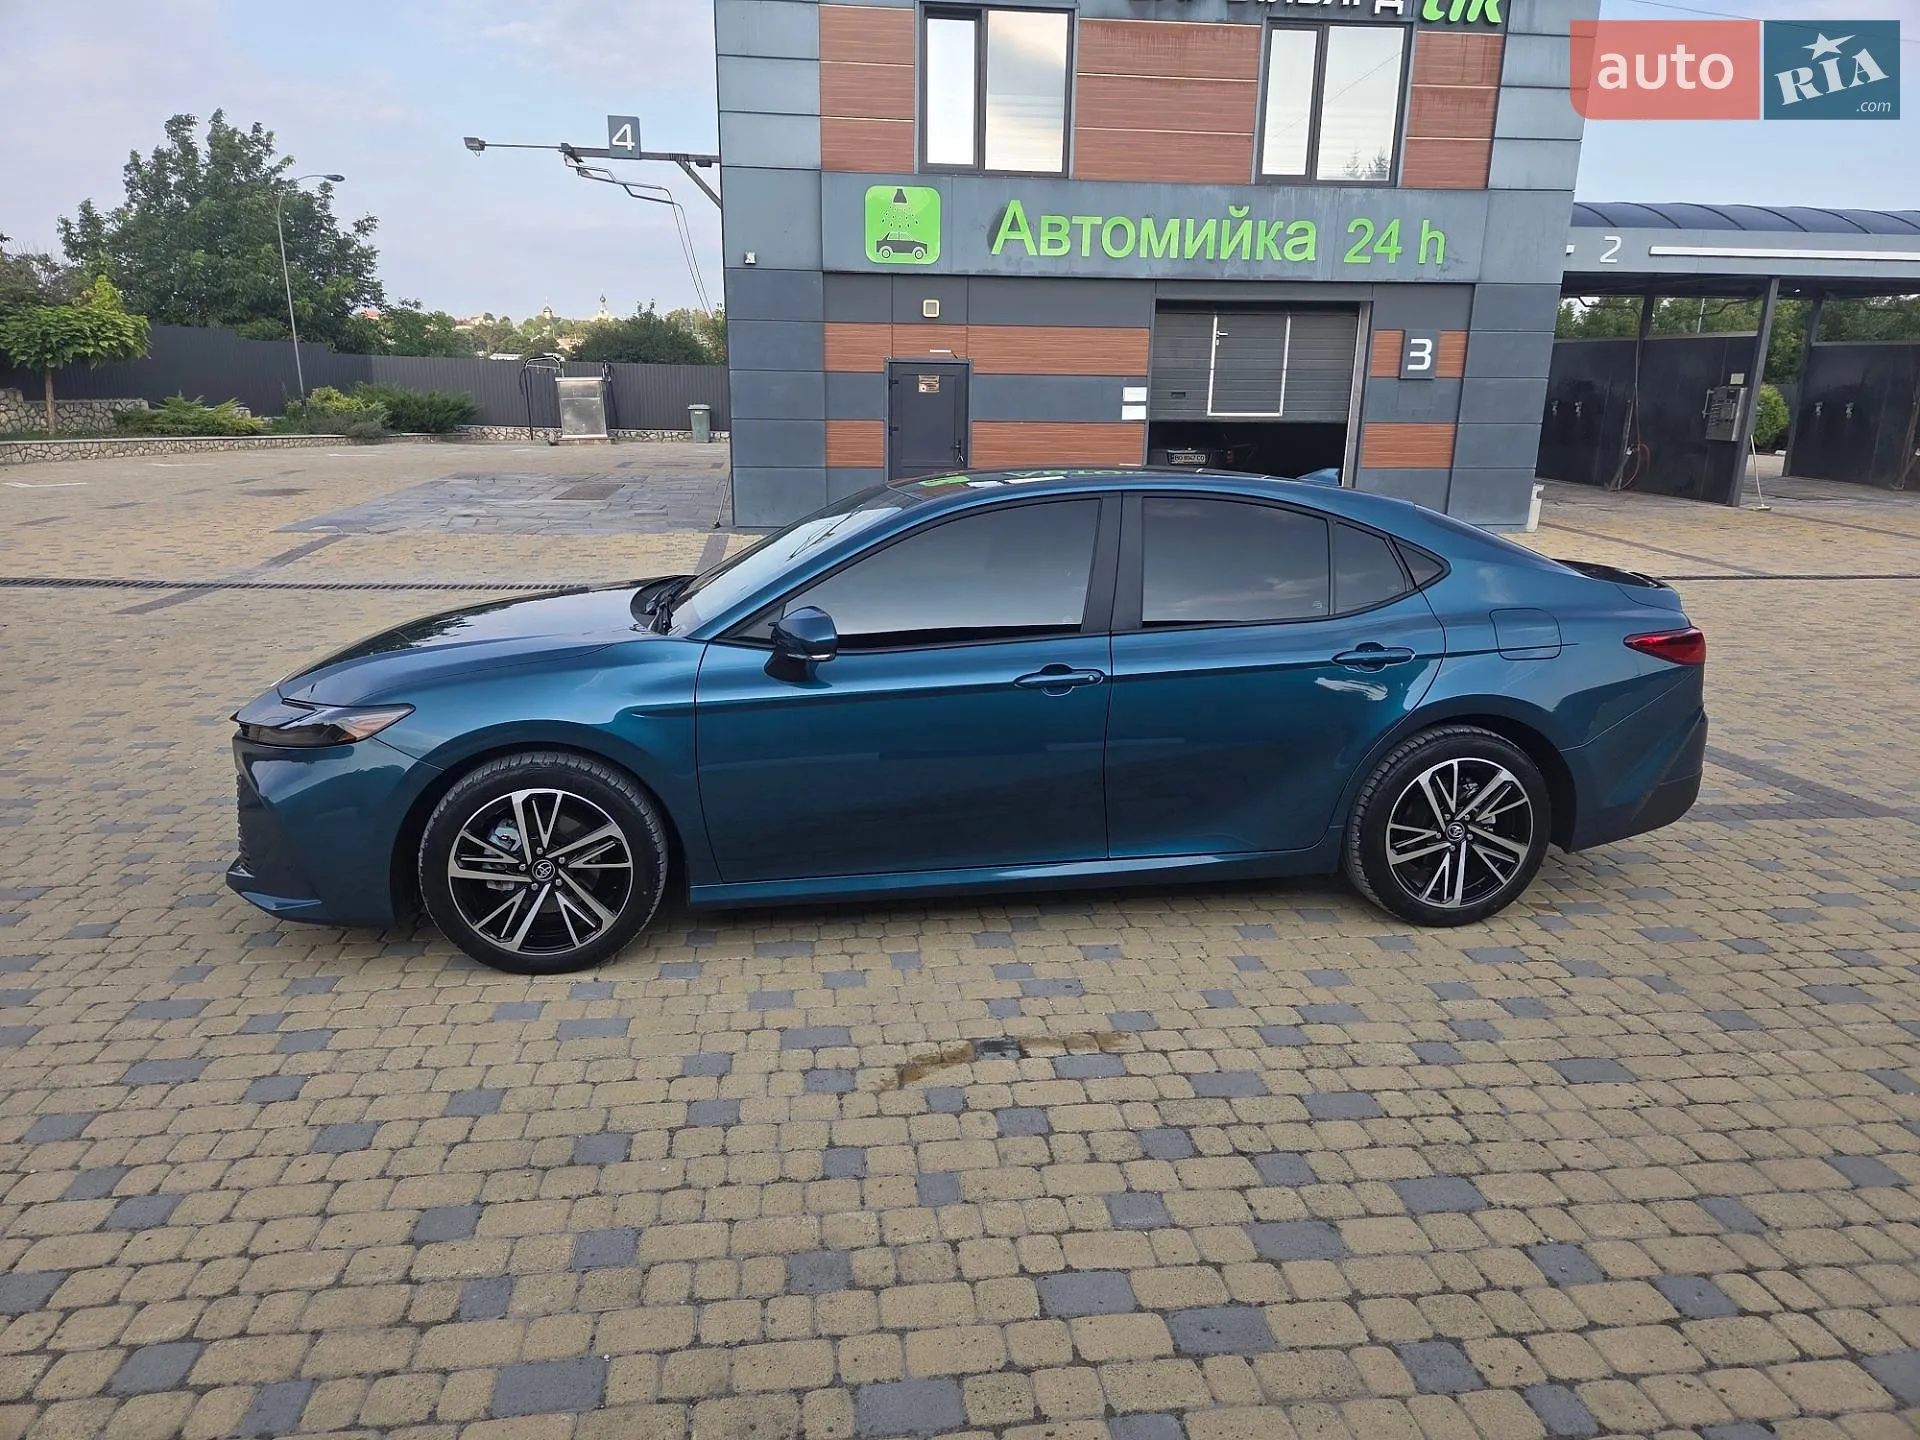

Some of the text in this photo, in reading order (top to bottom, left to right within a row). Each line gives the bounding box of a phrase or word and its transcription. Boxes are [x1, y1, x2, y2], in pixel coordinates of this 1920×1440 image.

[611, 123, 636, 151] 4
[992, 200, 1446, 264] Автомийка 24 h
[1599, 235, 1622, 263] 2
[1407, 338, 1433, 370] 3
